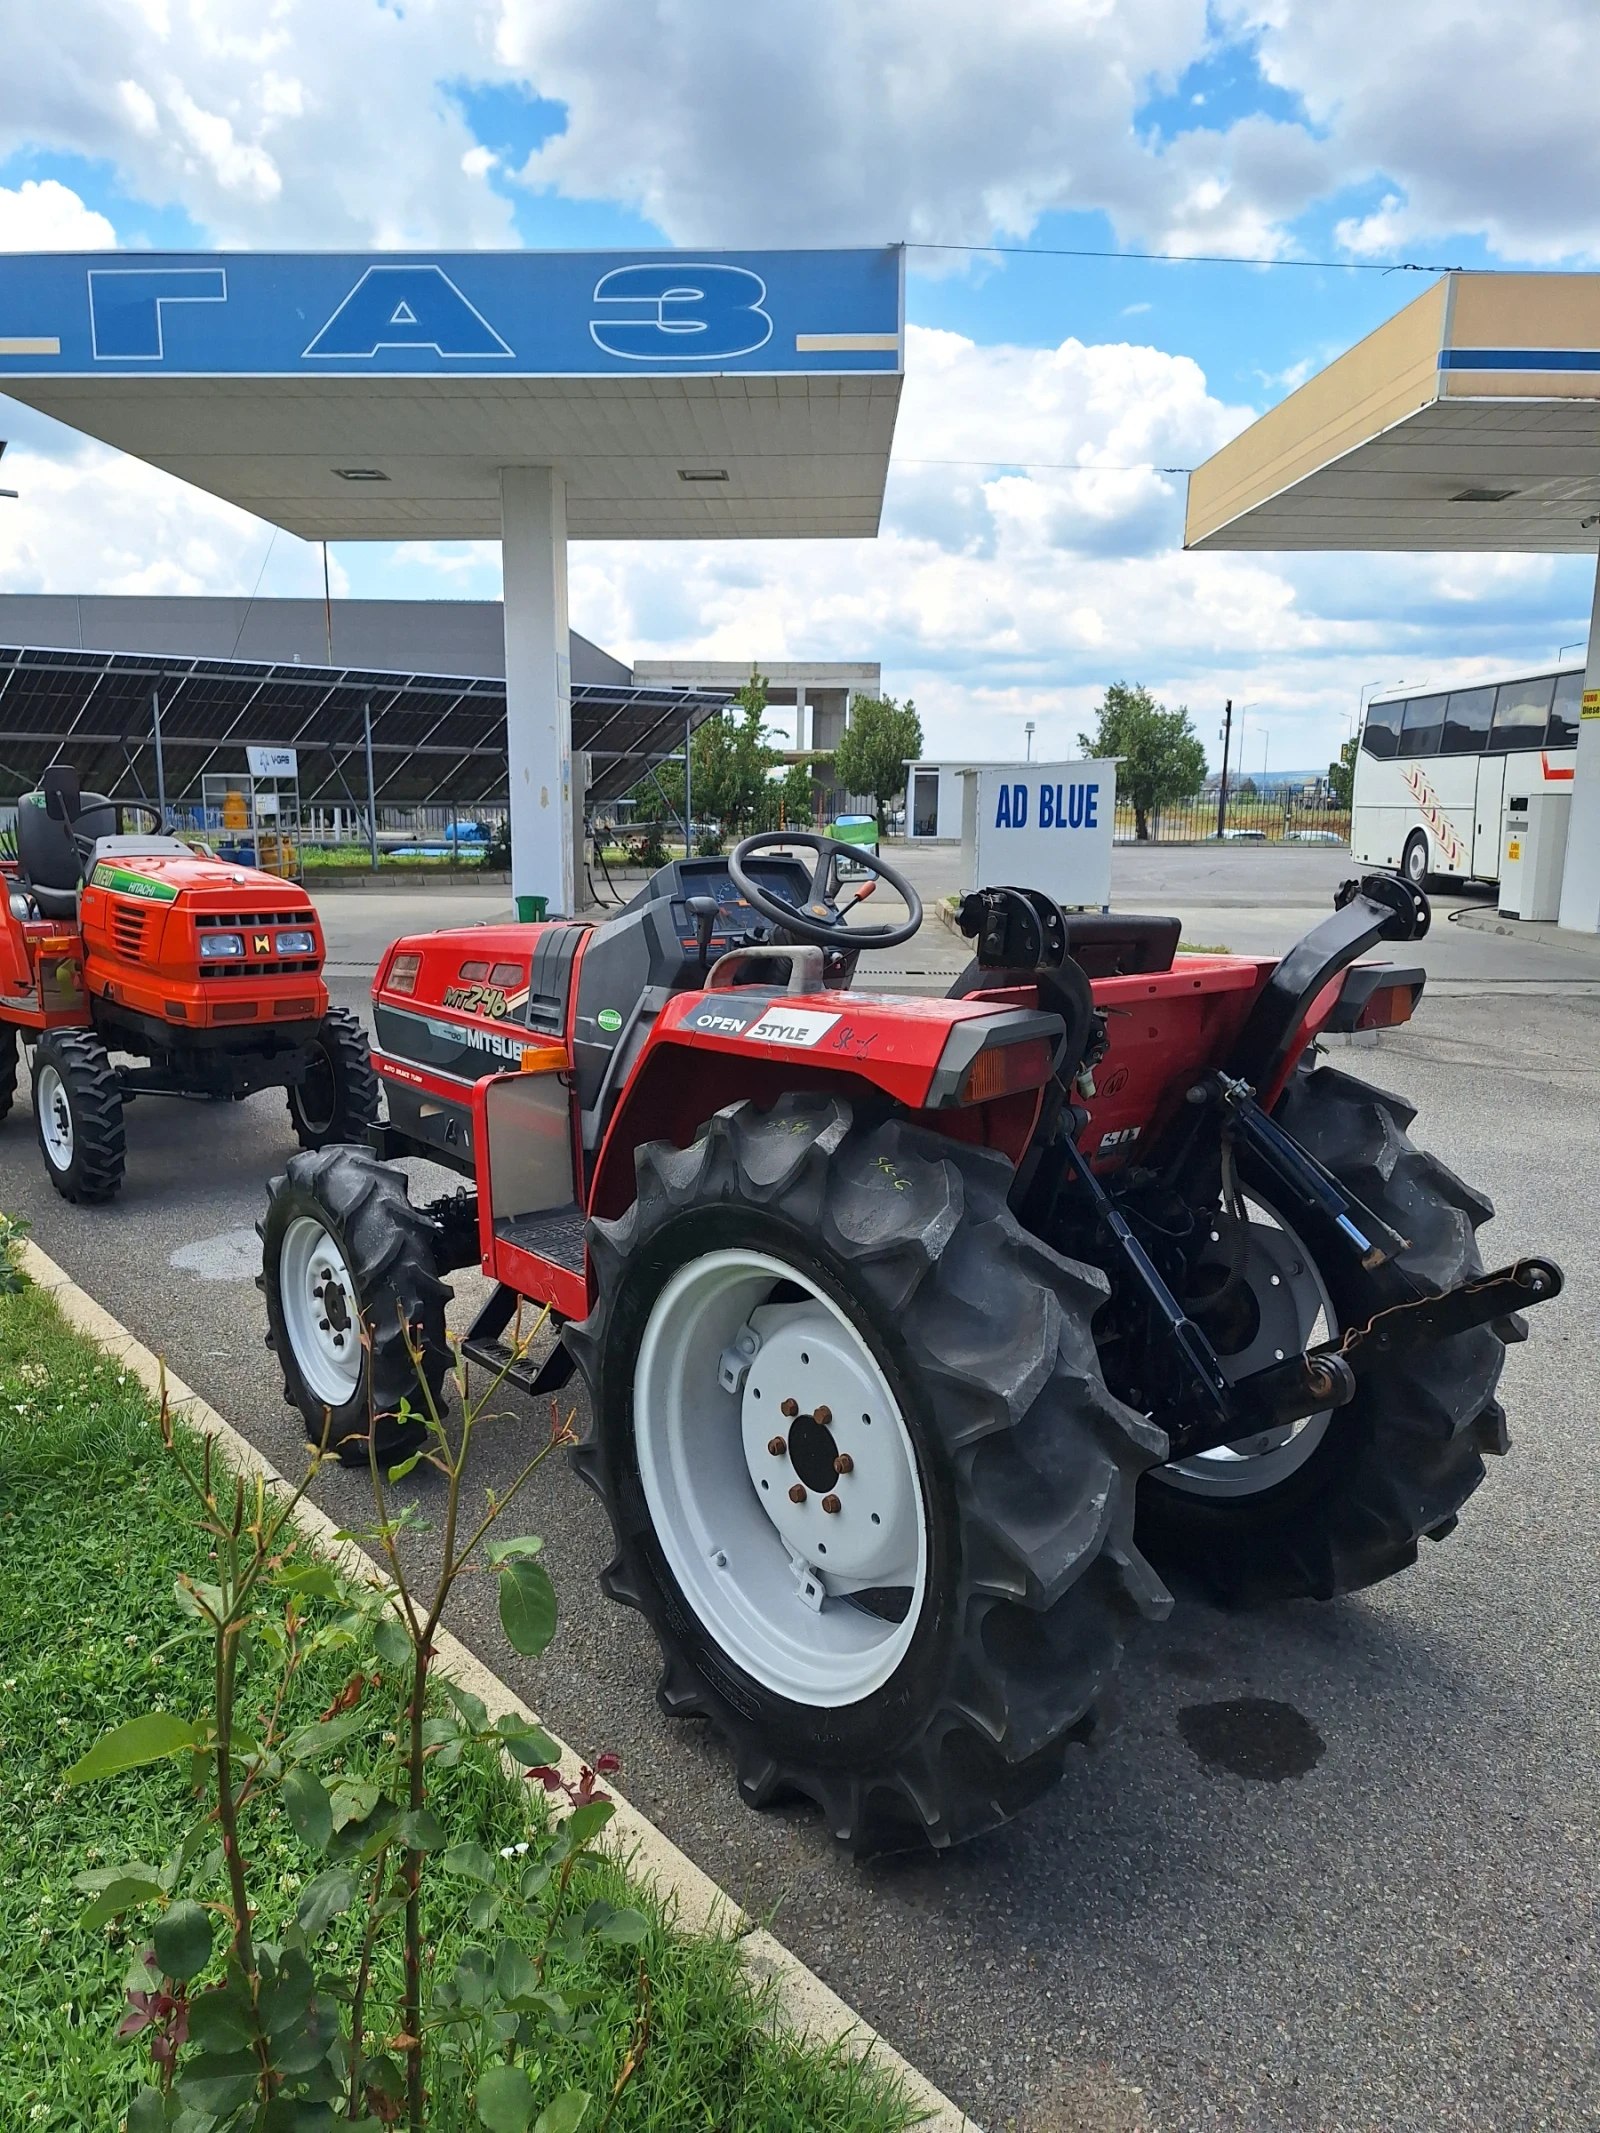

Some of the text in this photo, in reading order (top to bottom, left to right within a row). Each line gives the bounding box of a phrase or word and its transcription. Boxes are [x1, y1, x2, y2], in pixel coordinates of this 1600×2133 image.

[87, 263, 774, 361] ГАЗ
[1582, 705, 1600, 715] Diese
[995, 784, 1099, 829] AD BLUE
[127, 881, 157, 897] HITACHI
[443, 985, 507, 1019] MT246
[465, 1027, 539, 1062] MITSUB
[696, 1014, 810, 1041] OPEN STYLE
